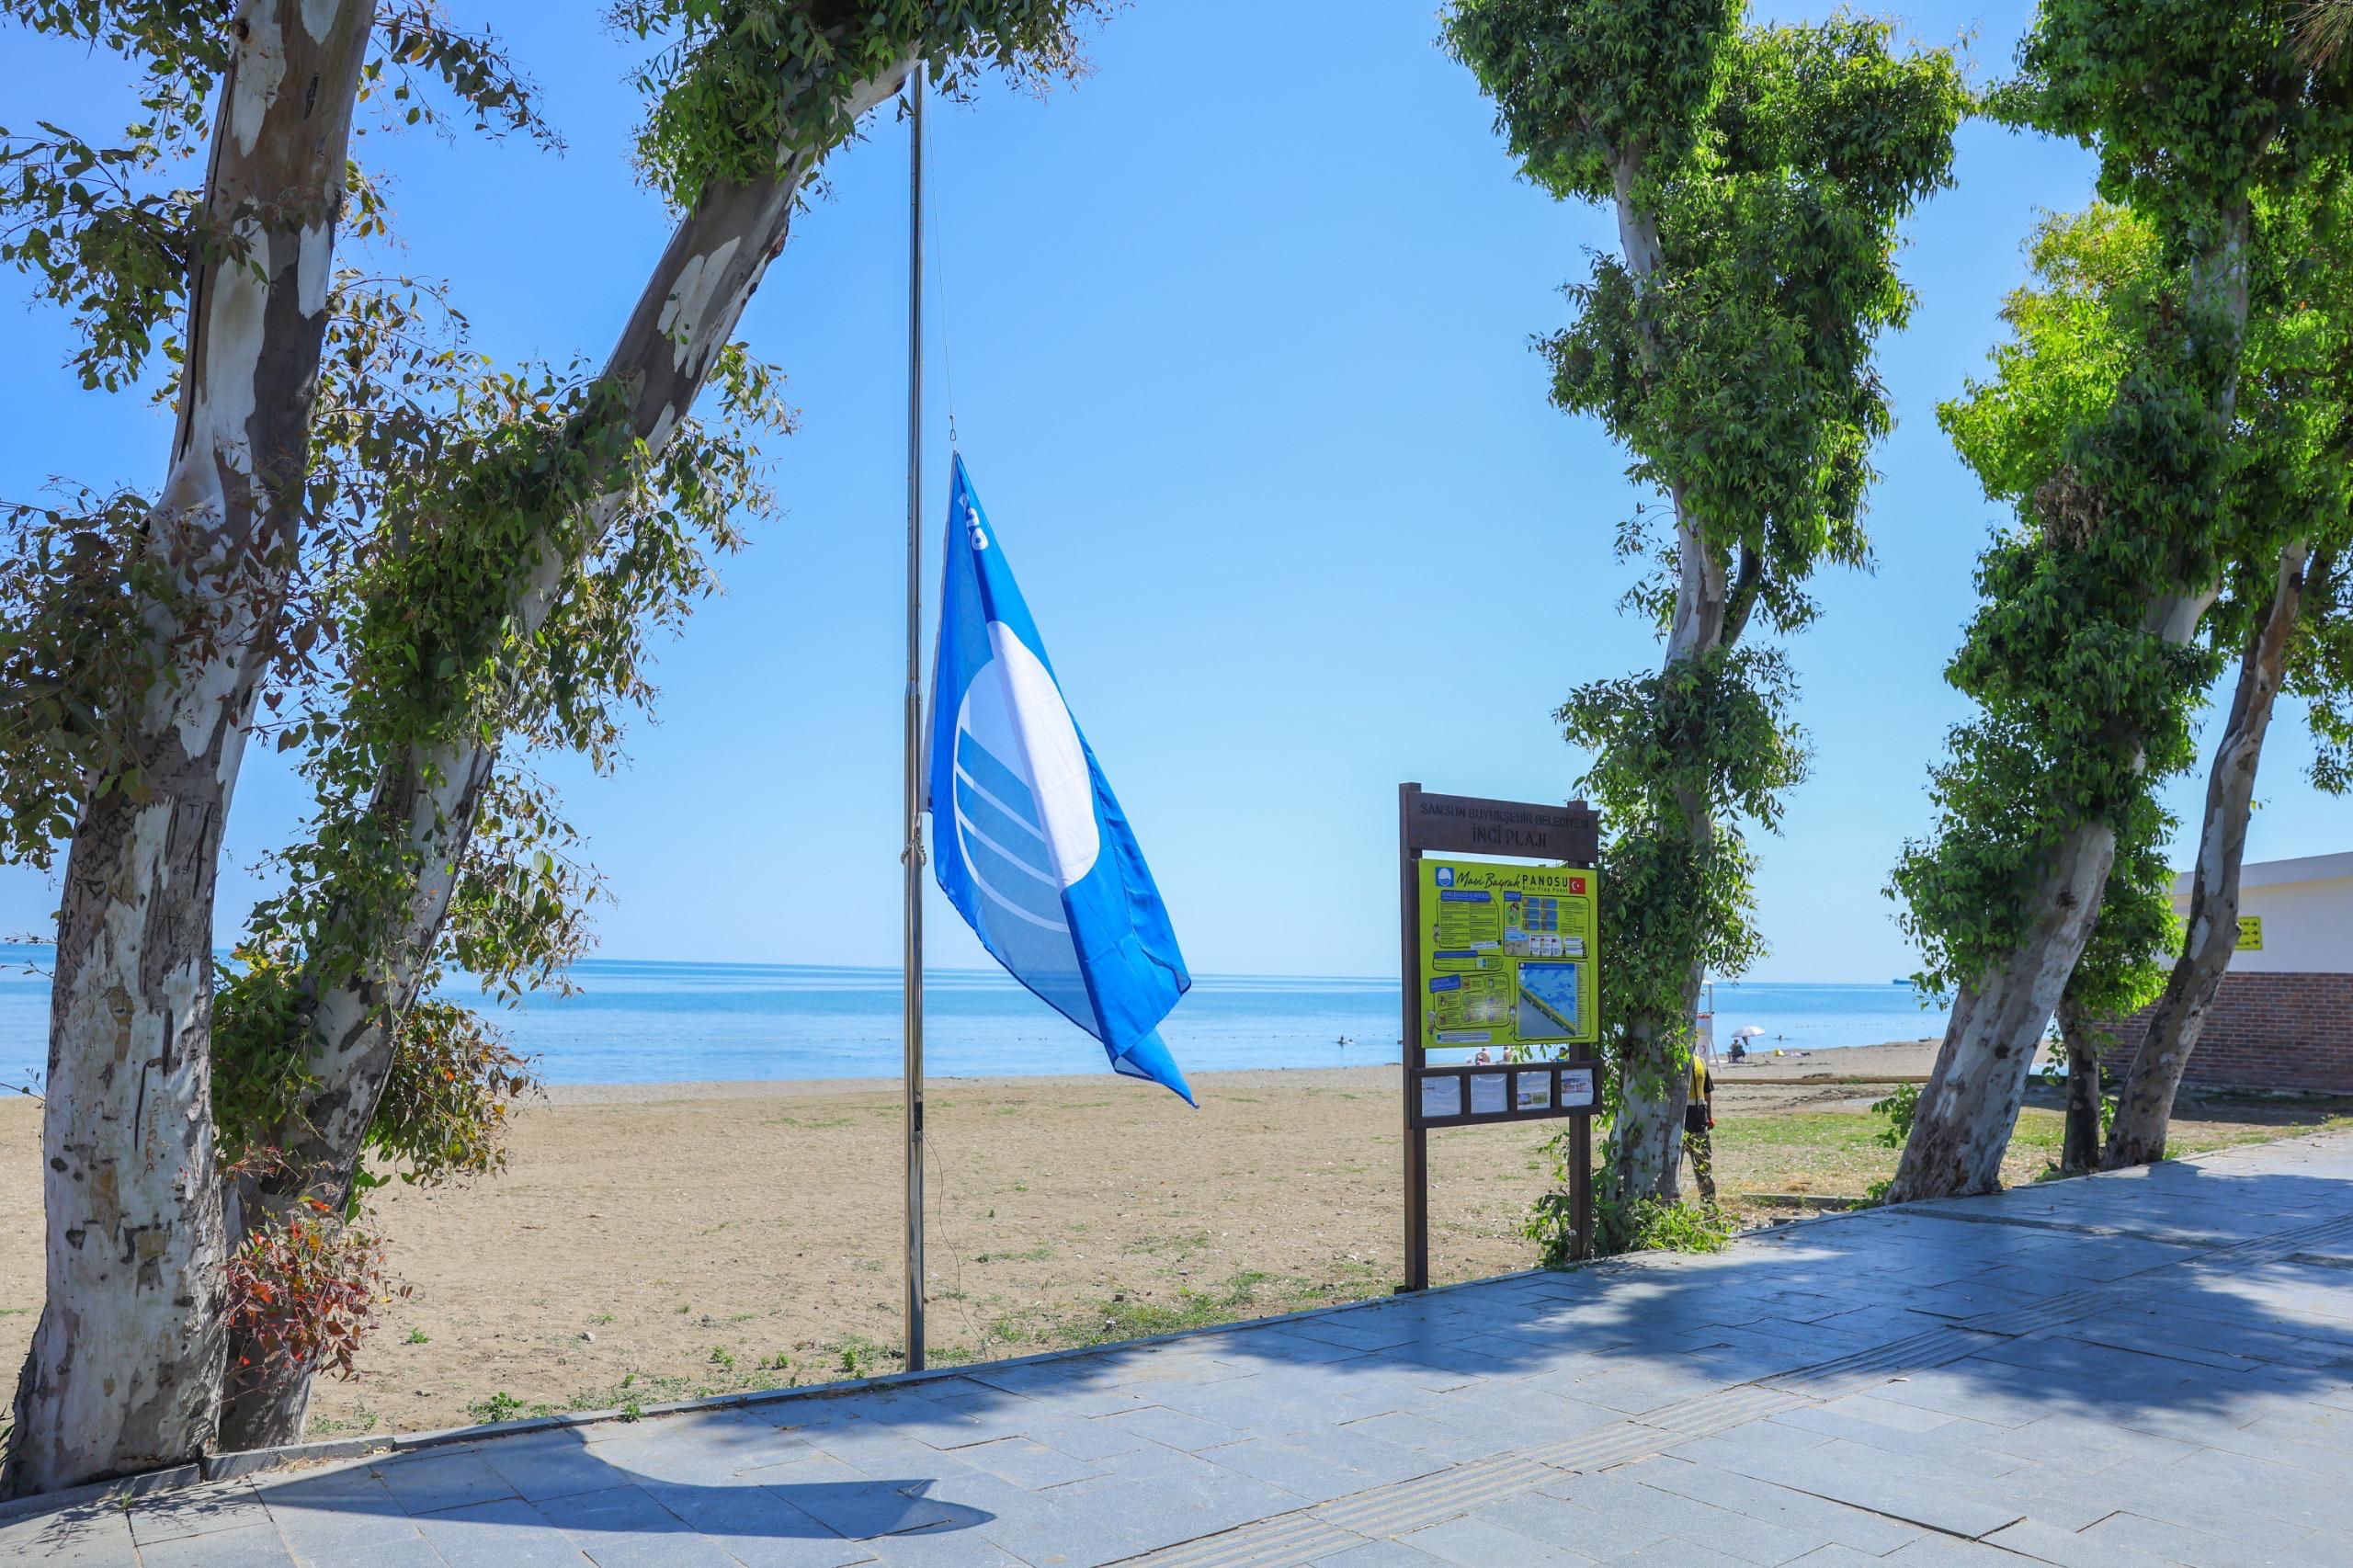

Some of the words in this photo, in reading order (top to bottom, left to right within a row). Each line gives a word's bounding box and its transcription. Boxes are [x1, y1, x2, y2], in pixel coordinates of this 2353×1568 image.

[1421, 802, 1466, 818] SAMSUN
[1506, 829, 1546, 848] PLAJI
[1456, 872, 1483, 888] Mavi
[1484, 872, 1520, 892] Bayrak
[1522, 874, 1568, 888] PANOSU
